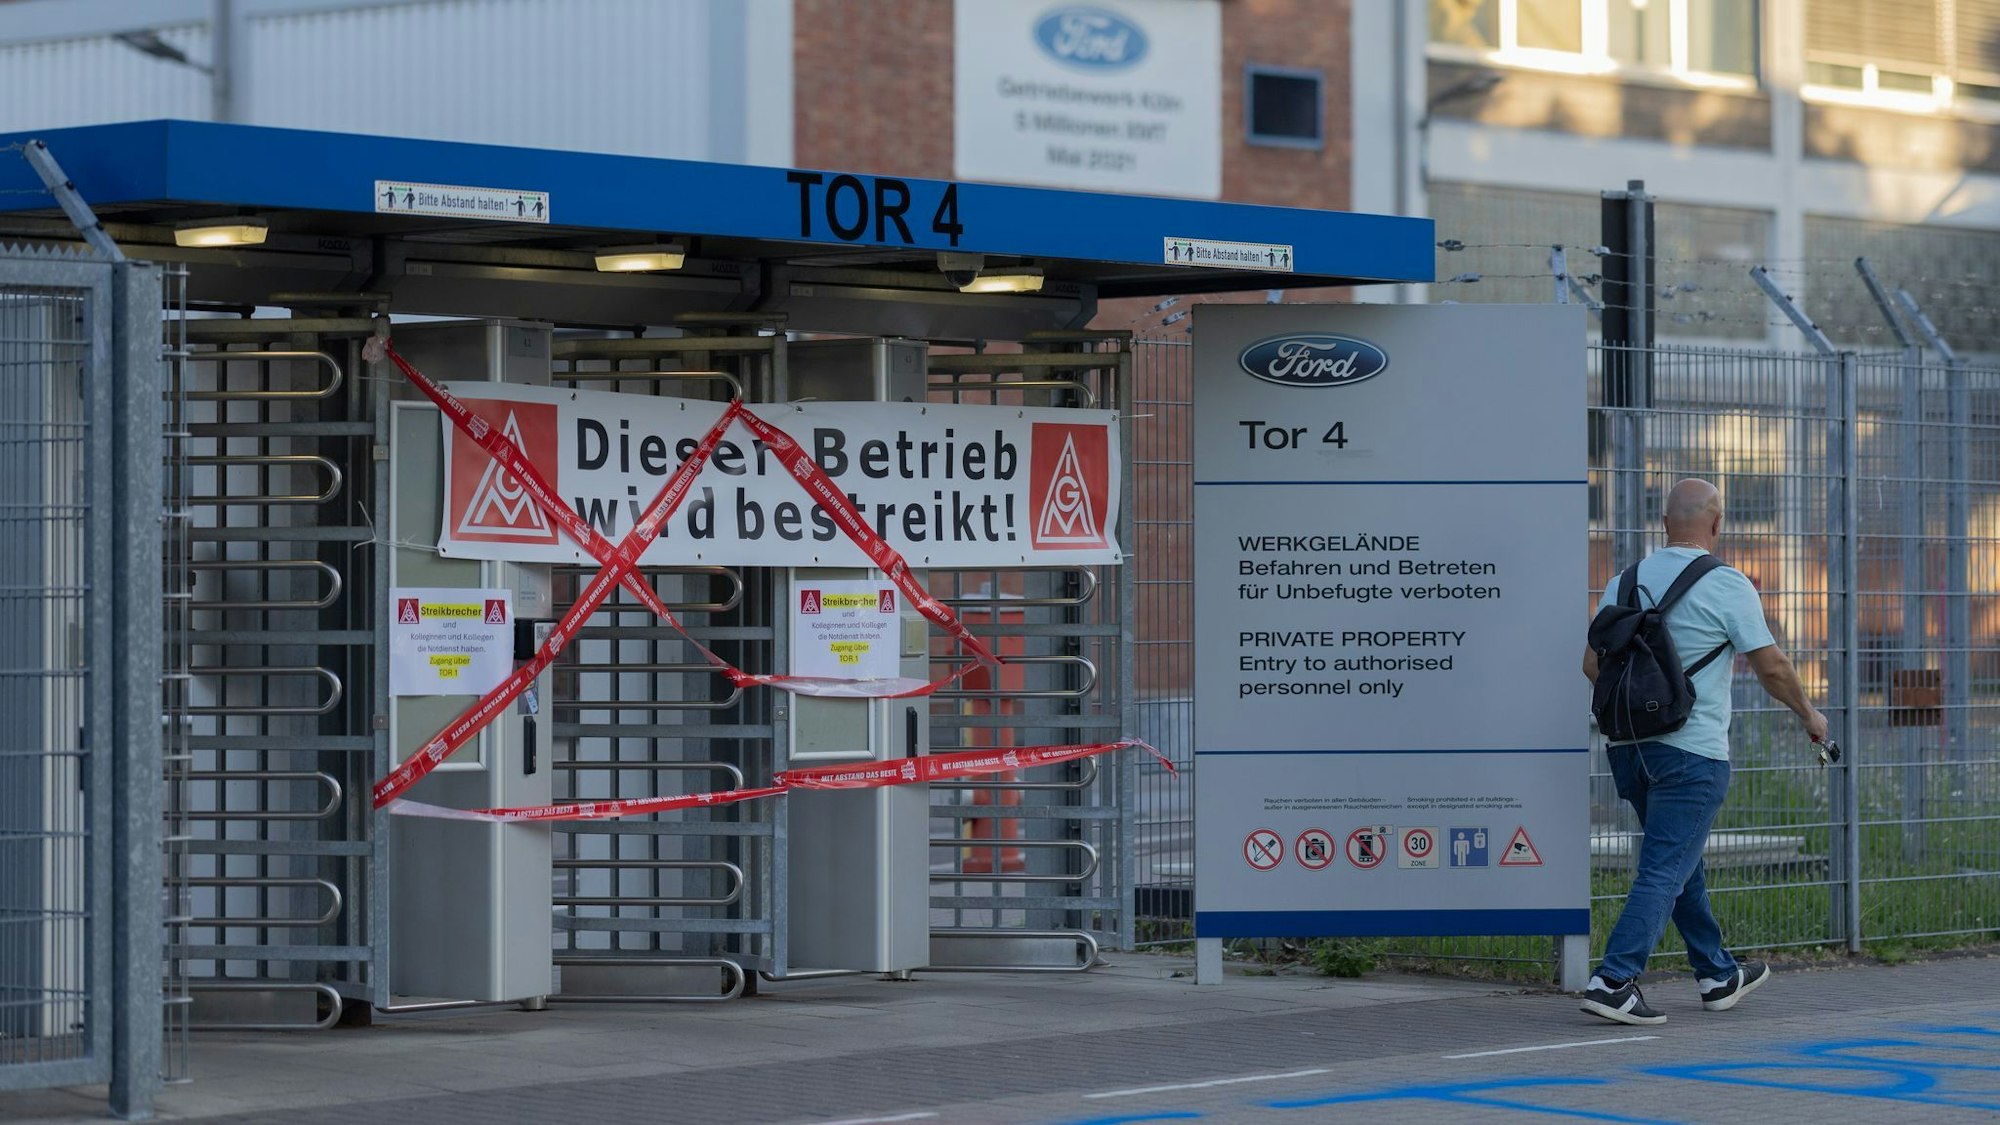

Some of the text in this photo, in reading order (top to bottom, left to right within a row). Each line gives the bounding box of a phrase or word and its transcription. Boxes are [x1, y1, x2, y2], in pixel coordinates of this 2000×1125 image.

[418, 192, 439, 207] Bitte
[441, 195, 475, 209] Abstand
[787, 171, 963, 247] TOR 4
[1196, 247, 1211, 259] Bitte
[1213, 248, 1239, 261] Abstand
[1268, 341, 1359, 377] Ford
[1239, 421, 1348, 449] Tor 4
[577, 417, 773, 477] Dieser
[814, 428, 1017, 481] Betrieb
[812, 478, 832, 498] BESTE
[828, 495, 842, 508] DAS
[575, 486, 715, 540] wid
[856, 528, 869, 541] MIT
[1239, 533, 1419, 551] WERKGELÄNDE
[1239, 560, 1495, 576] Befahren und Betreten
[564, 564, 620, 631] MIT ABSTAND DAS BESTE
[1238, 584, 1500, 603] für Unbefugte verboten
[822, 598, 877, 607] Streikbrecher
[421, 606, 482, 616] Streikbrecher
[812, 622, 846, 631] Kolleginnen
[410, 633, 446, 642] Kolleginnen
[463, 633, 494, 642] Kollegen
[1240, 632, 1466, 647] PRIVATE PROPERTY
[460, 645, 486, 653] haben.
[830, 644, 869, 653] Zugang über
[430, 657, 470, 666] Zugang über
[1240, 655, 1453, 674] Entry to authorised
[439, 669, 453, 677] TOR
[509, 676, 522, 688] MIT
[1240, 679, 1403, 698] personnel only
[481, 685, 511, 713] ABSTAND
[468, 709, 484, 724] DAS
[449, 720, 471, 740] BESTE
[834, 770, 865, 784] ABSTAND
[864, 769, 879, 779] DAS
[878, 767, 897, 779] BESTE
[379, 781, 394, 795] MIT
[516, 807, 544, 820] ABSTAND
[544, 806, 556, 816] DAS
[555, 804, 574, 815] BESTE
[1411, 837, 1427, 851] 30
